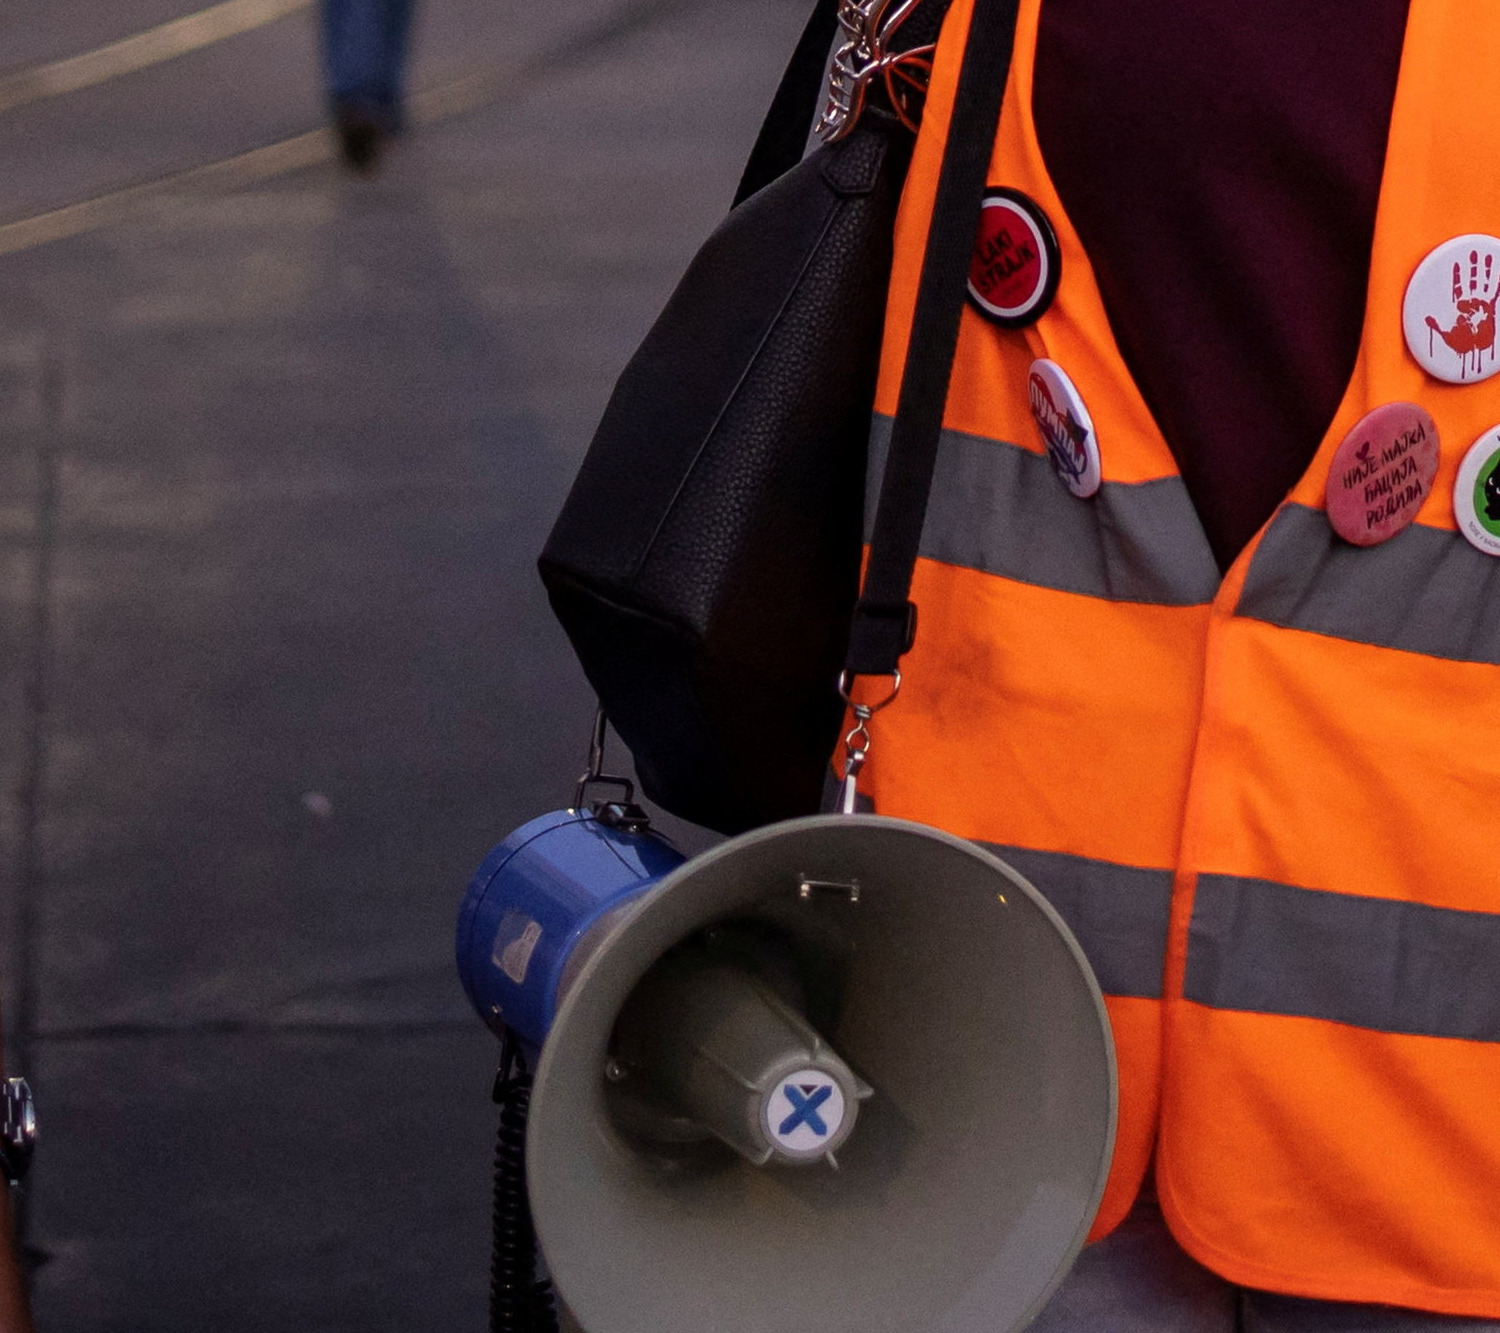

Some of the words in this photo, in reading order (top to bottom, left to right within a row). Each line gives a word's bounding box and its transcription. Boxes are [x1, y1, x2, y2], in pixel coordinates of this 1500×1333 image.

[981, 240, 1037, 295] STRAJK
[1030, 379, 1085, 473] ПУМПАЈ
[1343, 455, 1379, 490] НИЈЕ
[1380, 422, 1426, 466] МАЈКА
[1366, 478, 1423, 530] РОДИЛА
